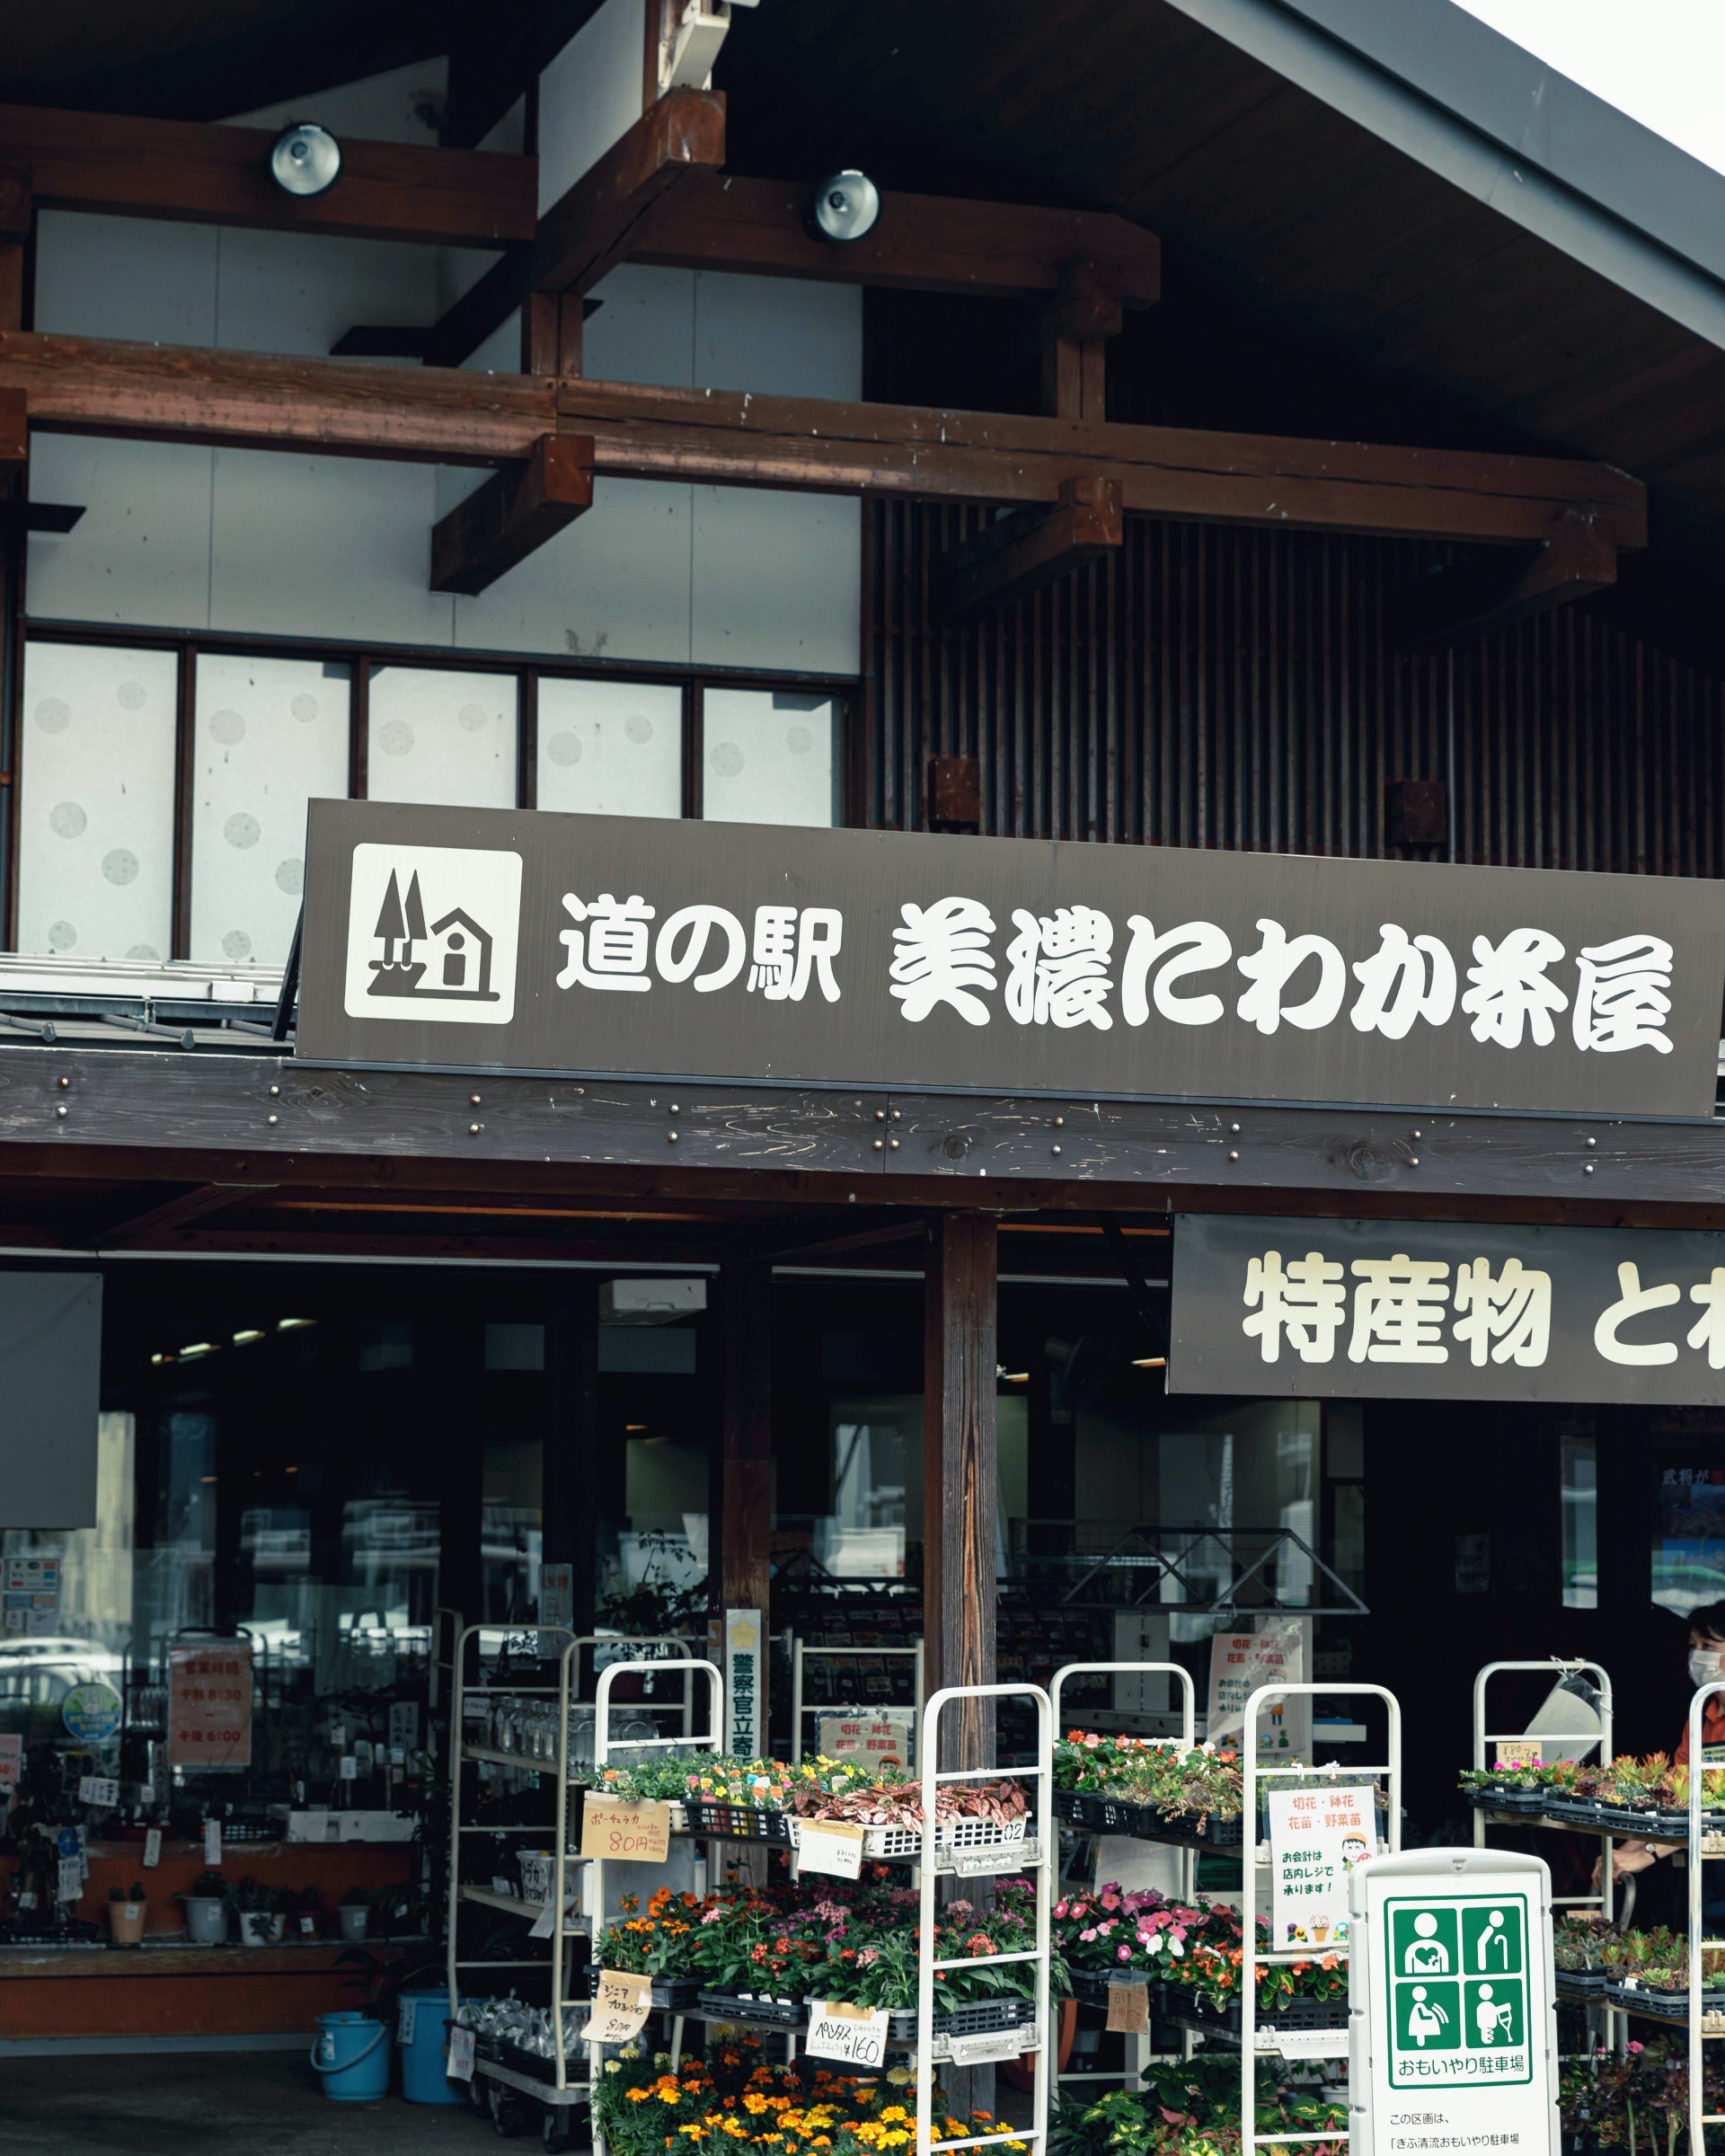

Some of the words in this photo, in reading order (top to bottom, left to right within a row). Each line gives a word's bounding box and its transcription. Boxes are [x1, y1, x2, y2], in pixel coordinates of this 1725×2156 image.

[556, 893, 842, 1003] 道の駅
[889, 896, 1673, 1055] 美濃にわか茶屋
[1243, 1250, 1552, 1367] 特産物
[1293, 1795, 1354, 1810] 切花・鉢花
[1288, 1813, 1361, 1830] 花苗・野菜苗
[609, 1831, 648, 1851] 80円
[1282, 1851, 1322, 1863] お会計は
[1283, 1866, 1334, 1880] 店内レジで
[1398, 2054, 1525, 2076] おもいやり駐車場
[1390, 2113, 1449, 2125] この区画は、
